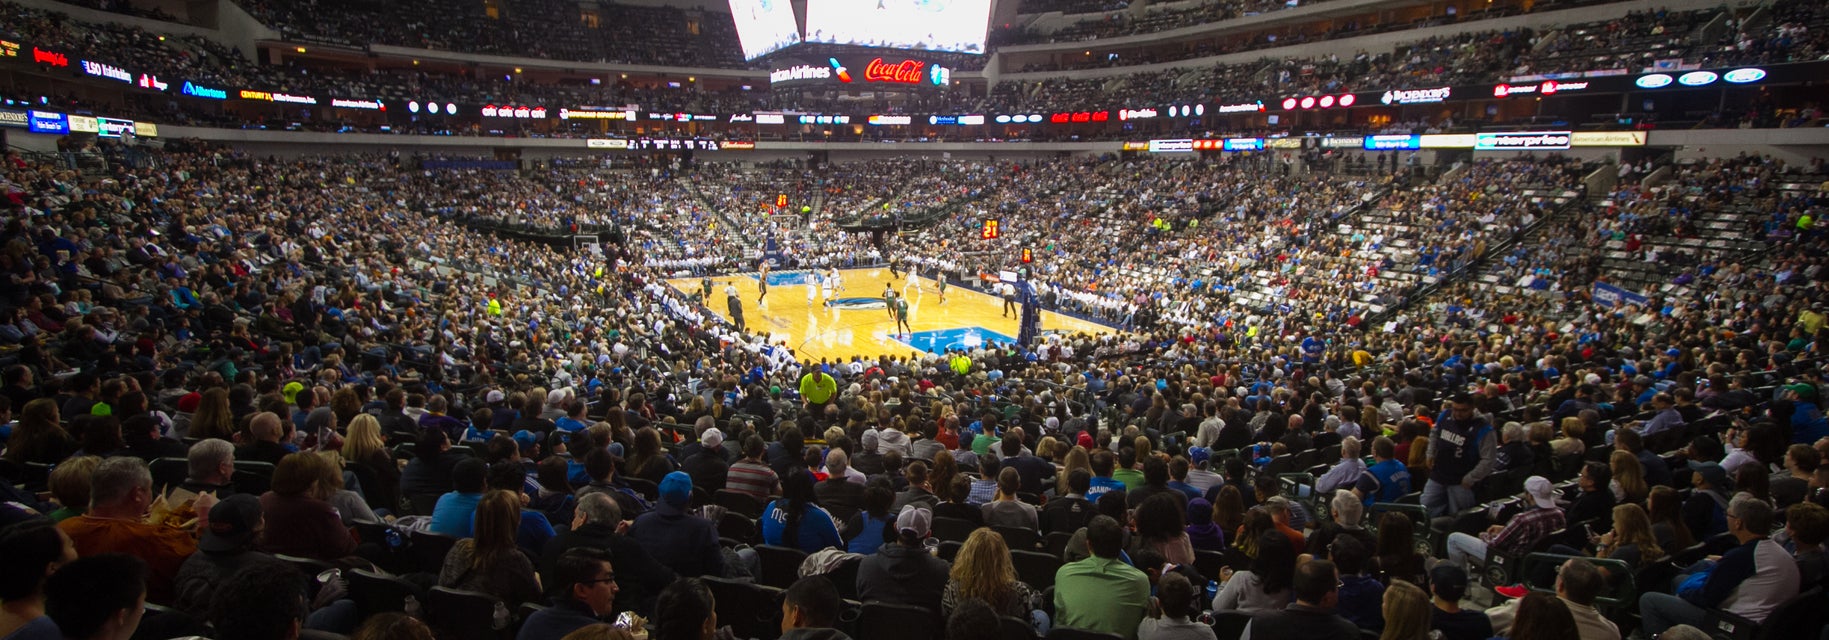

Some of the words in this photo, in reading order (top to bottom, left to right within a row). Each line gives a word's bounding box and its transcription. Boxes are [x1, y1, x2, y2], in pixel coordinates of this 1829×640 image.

[86, 61, 101, 76] LSO
[791, 65, 830, 80] Airlines
[865, 57, 925, 85] Coca-Cola
[240, 90, 264, 100] CENTURY
[1478, 134, 1569, 147] enterprise
[1604, 135, 1631, 143] Airlines
[983, 226, 997, 238] 21
